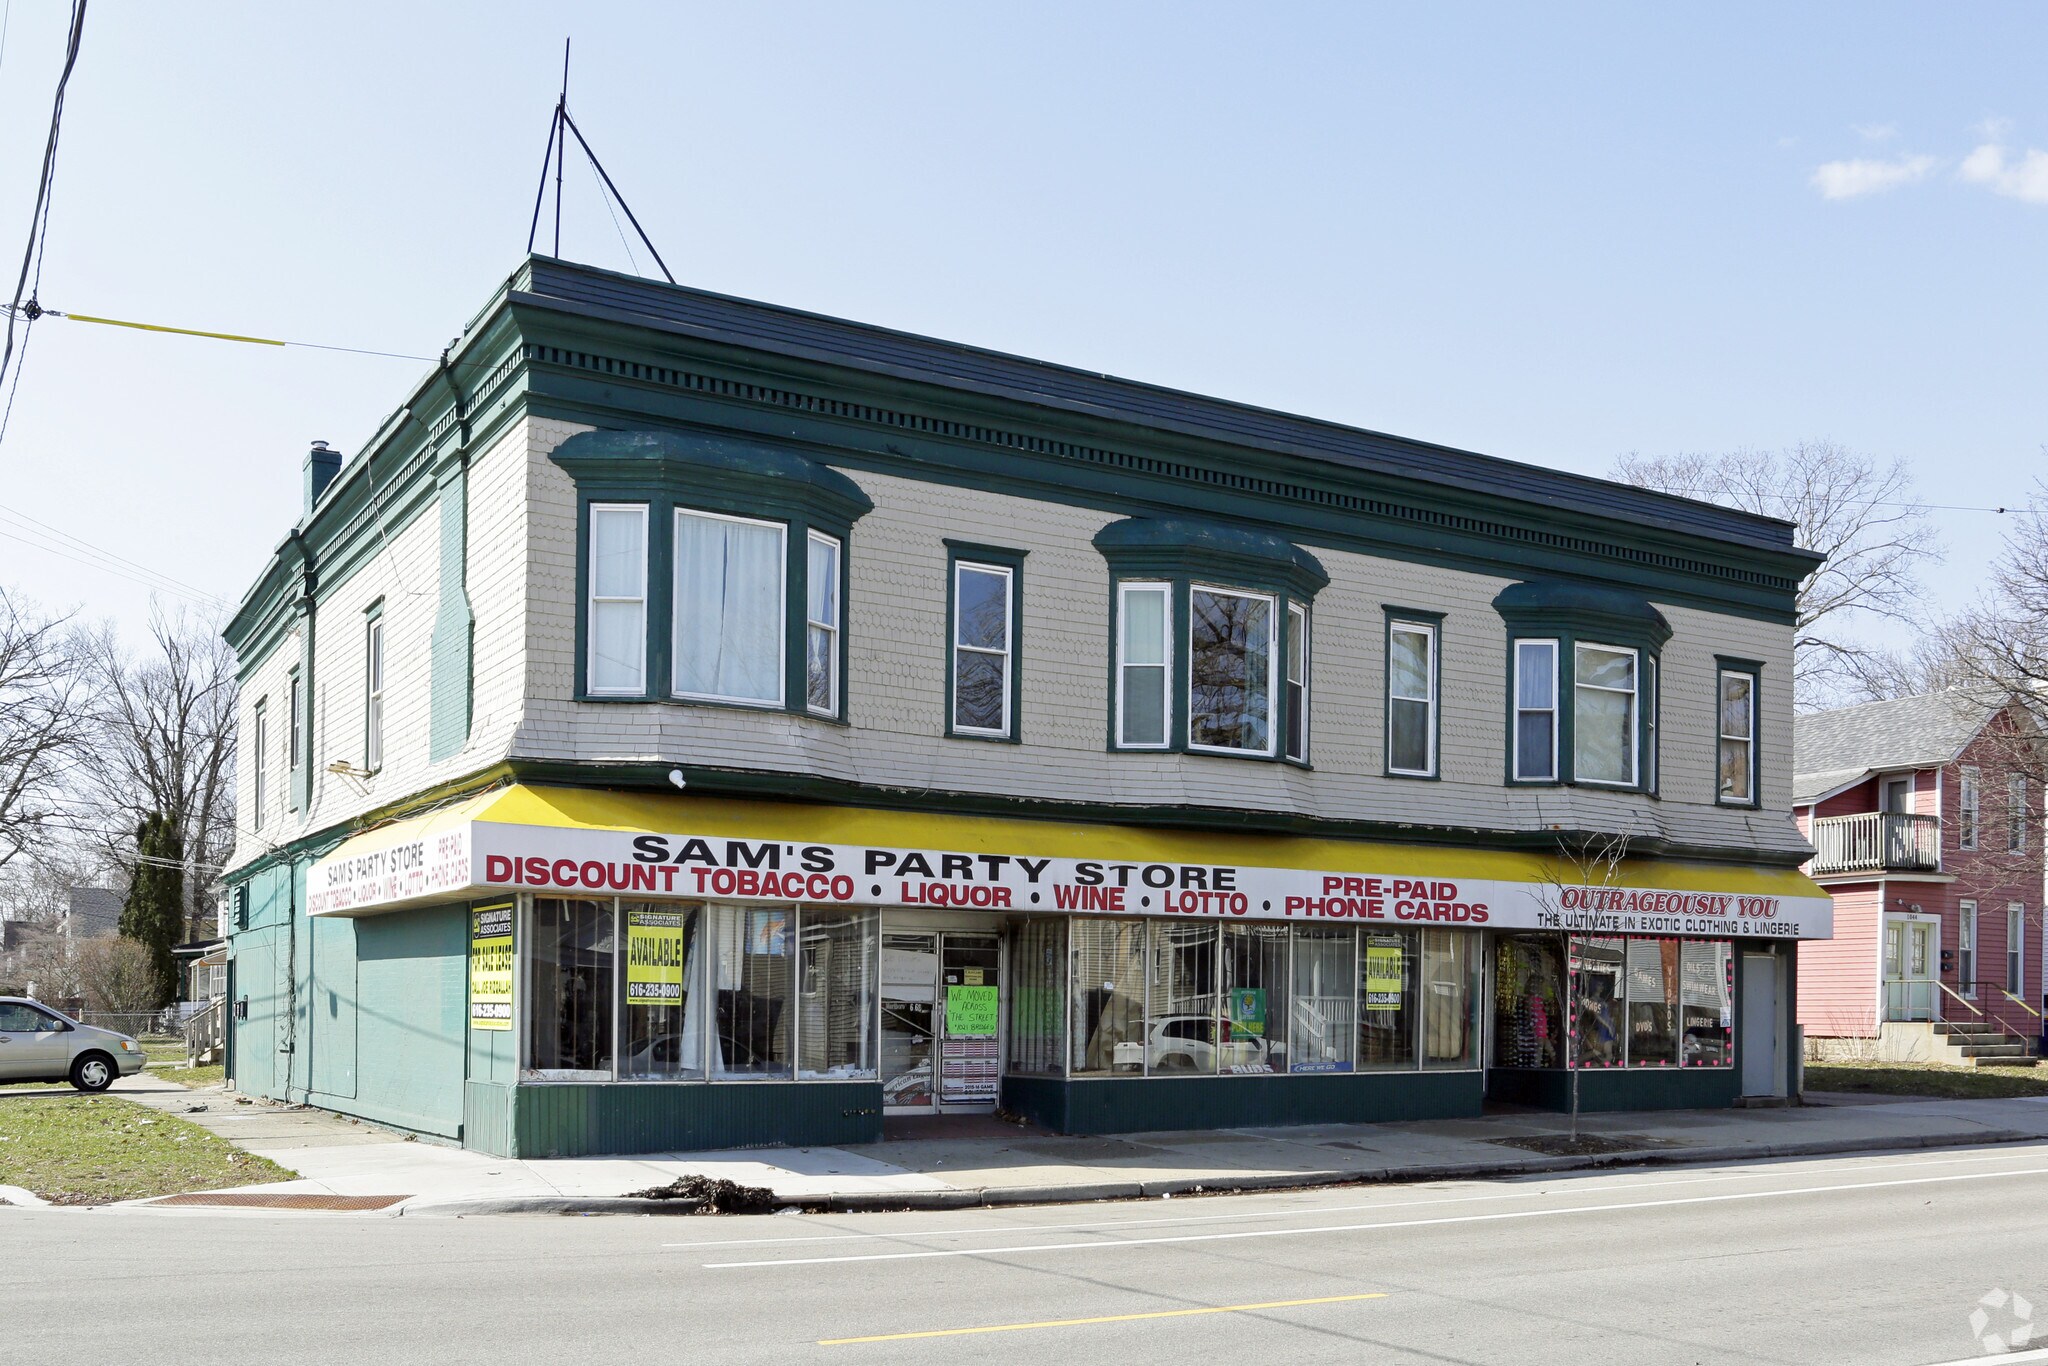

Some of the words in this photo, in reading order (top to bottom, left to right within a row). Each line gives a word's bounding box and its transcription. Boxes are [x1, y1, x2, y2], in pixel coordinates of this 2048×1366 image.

[356, 851, 387, 880] PARTY
[390, 842, 424, 873] STORE
[632, 835, 835, 873] SAM'S
[864, 849, 1052, 883] PARTY
[1075, 862, 1237, 891] STORE
[404, 870, 424, 895] LOTTO
[485, 855, 680, 892] DISCOUNT
[691, 867, 855, 901] TOBACCO
[901, 881, 1012, 908] LIQUOR
[1053, 883, 1125, 911] WINE
[1164, 889, 1249, 915] LOTTO
[1322, 876, 1458, 900] PRE-PAID
[1285, 896, 1385, 919] PHONE
[1394, 901, 1489, 923] CARDS
[1560, 887, 1733, 918] OUTRAGEOUSLY
[1736, 897, 1781, 919] YOU
[480, 909, 512, 923] SIGNATURE
[1538, 913, 1560, 927] THE
[1565, 913, 1619, 930] ULTIMATE
[1624, 916, 1636, 930] IN
[1641, 917, 1681, 932] EXOTIC
[1686, 918, 1738, 934] CLOTHING
[1742, 921, 1750, 933] &
[1754, 921, 1800, 936] LINGERIE
[480, 921, 511, 935] ASSOCIATES
[630, 937, 681, 967] AVAILABLE
[1369, 956, 1400, 979] AVAILABLE
[1634, 967, 1656, 987] GAMES
[629, 983, 680, 997] 616-235-0900
[951, 990, 961, 1001] WE
[966, 990, 993, 1001] MOVED
[1683, 980, 1716, 996] SWIMWEAR
[951, 1012, 964, 1021] THE
[969, 1013, 995, 1022] STREET
[961, 1002, 988, 1012] ACROSS
[1686, 1017, 1713, 1028] LINGERIE
